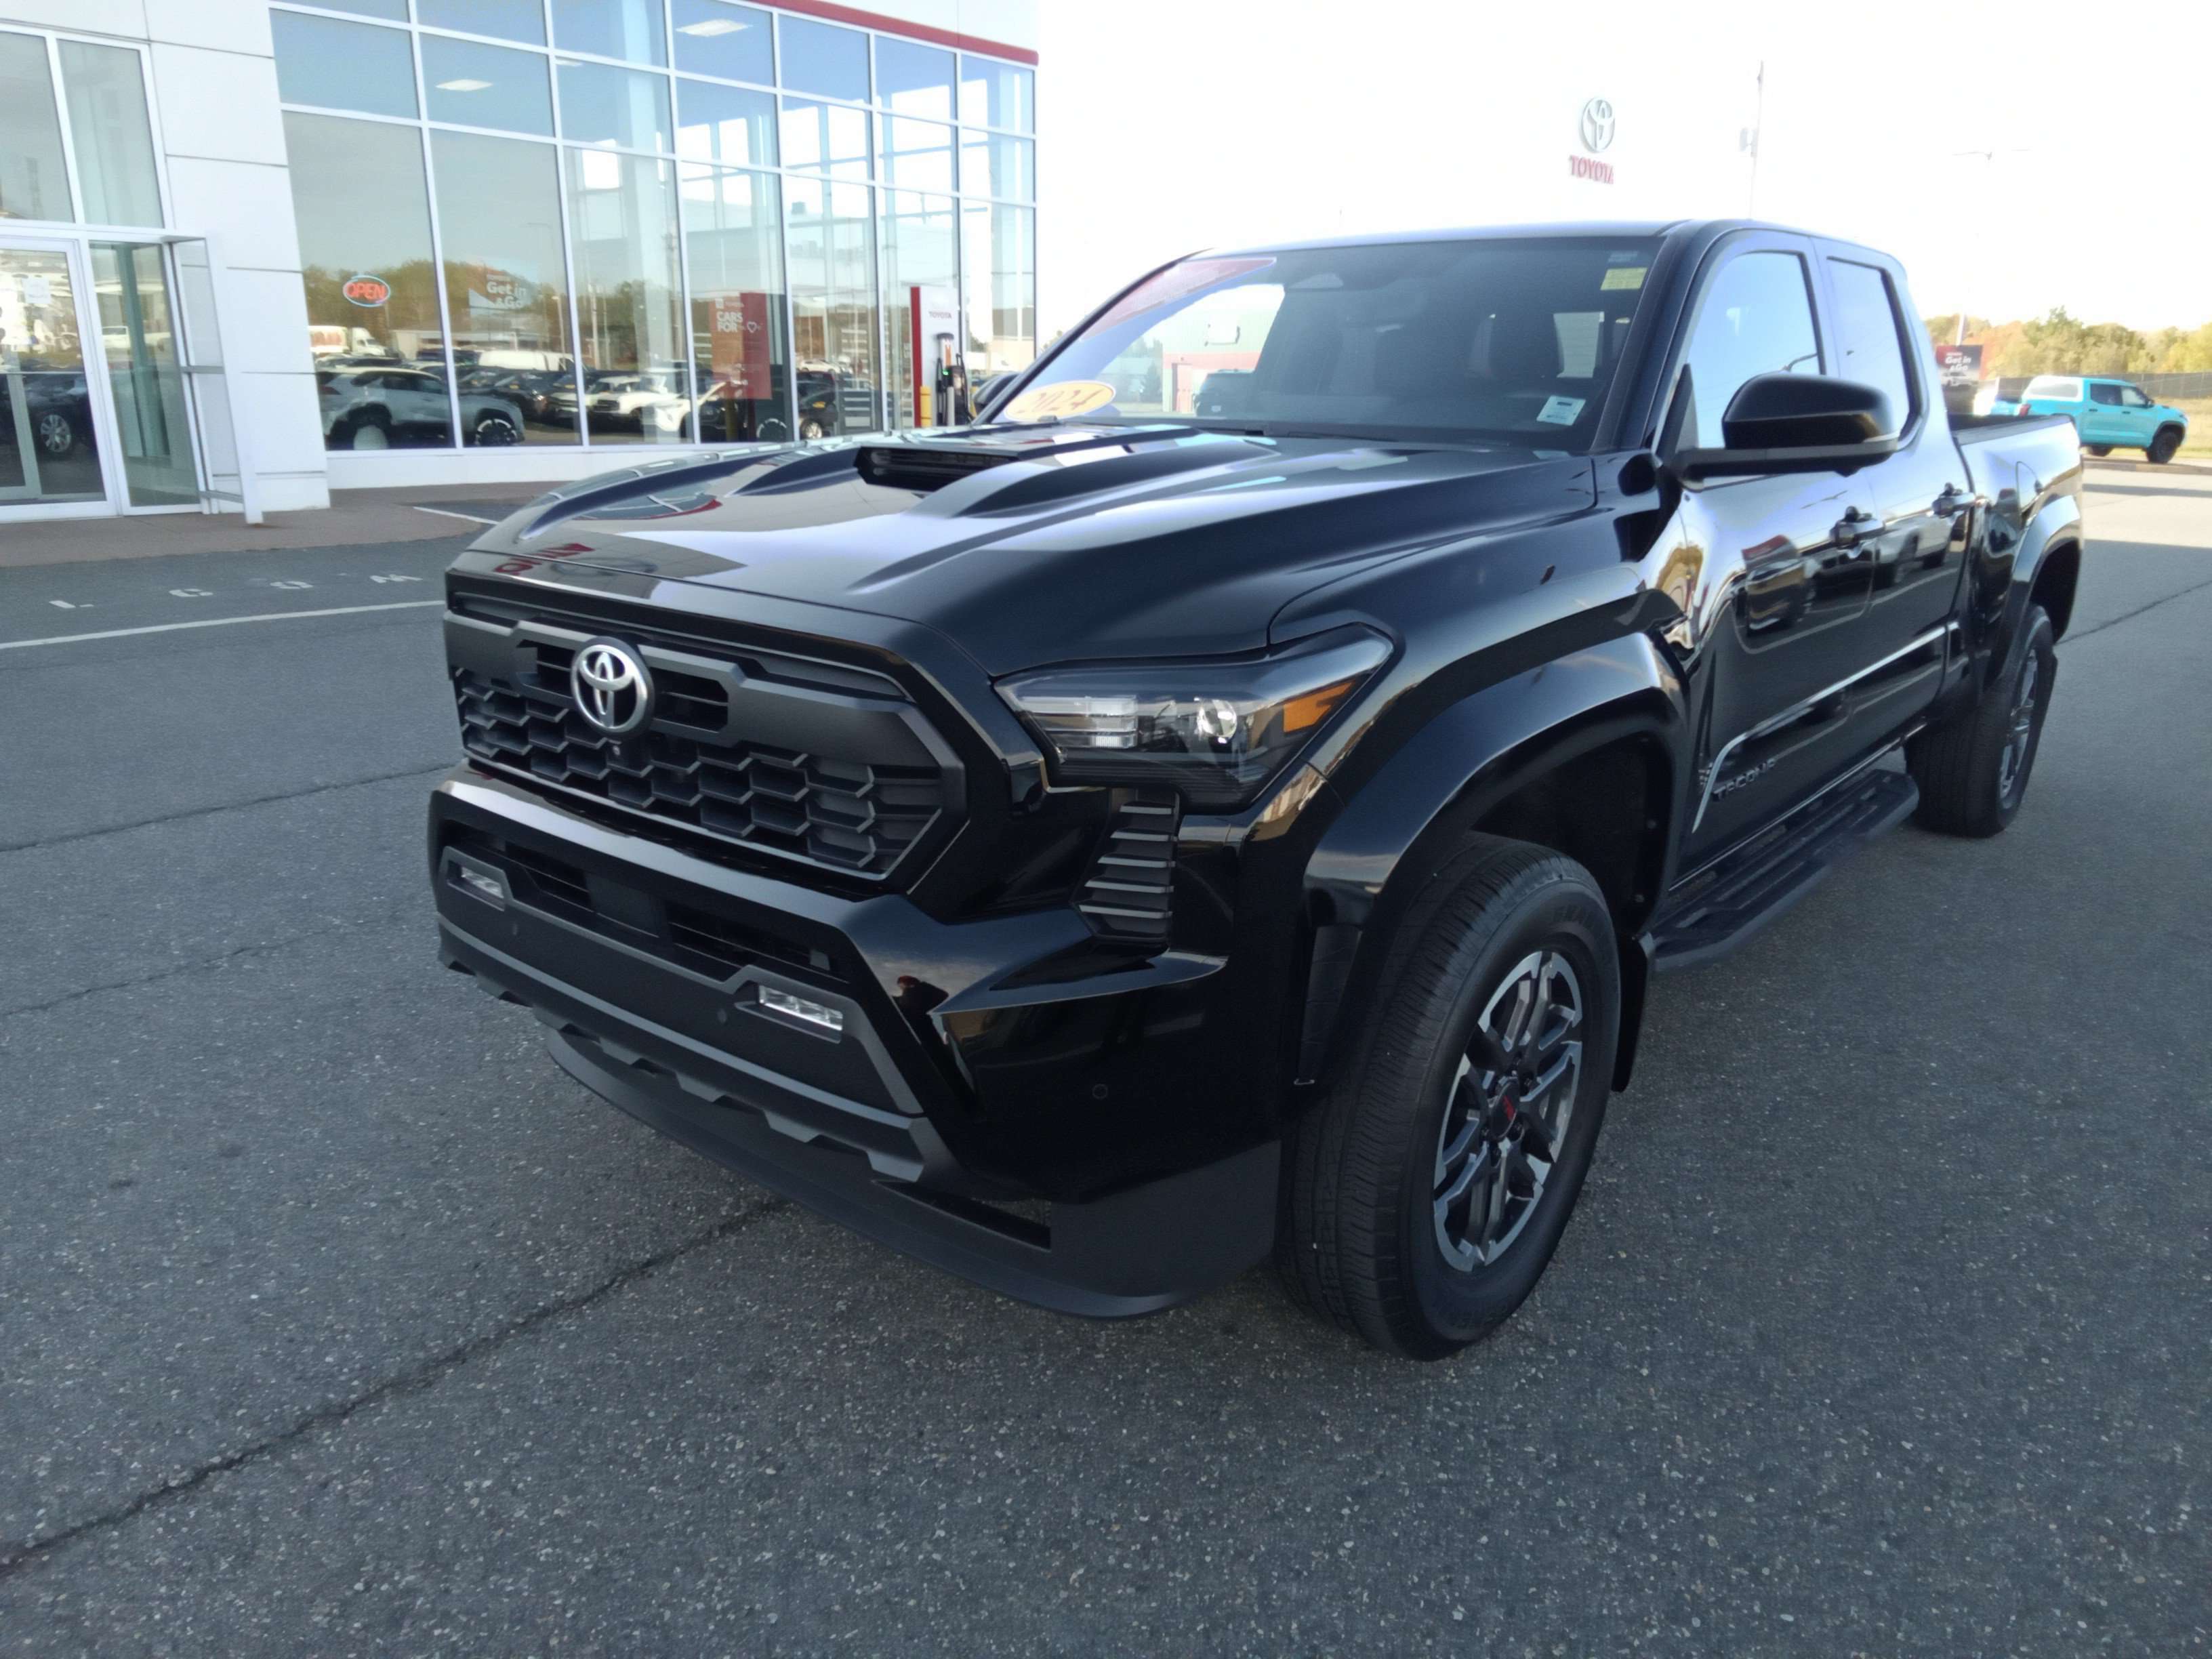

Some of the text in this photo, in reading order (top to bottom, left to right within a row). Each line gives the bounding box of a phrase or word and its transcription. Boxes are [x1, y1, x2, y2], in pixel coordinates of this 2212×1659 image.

[346, 283, 386, 300] OPEN
[716, 312, 743, 323] CARS
[717, 321, 738, 333] FOR
